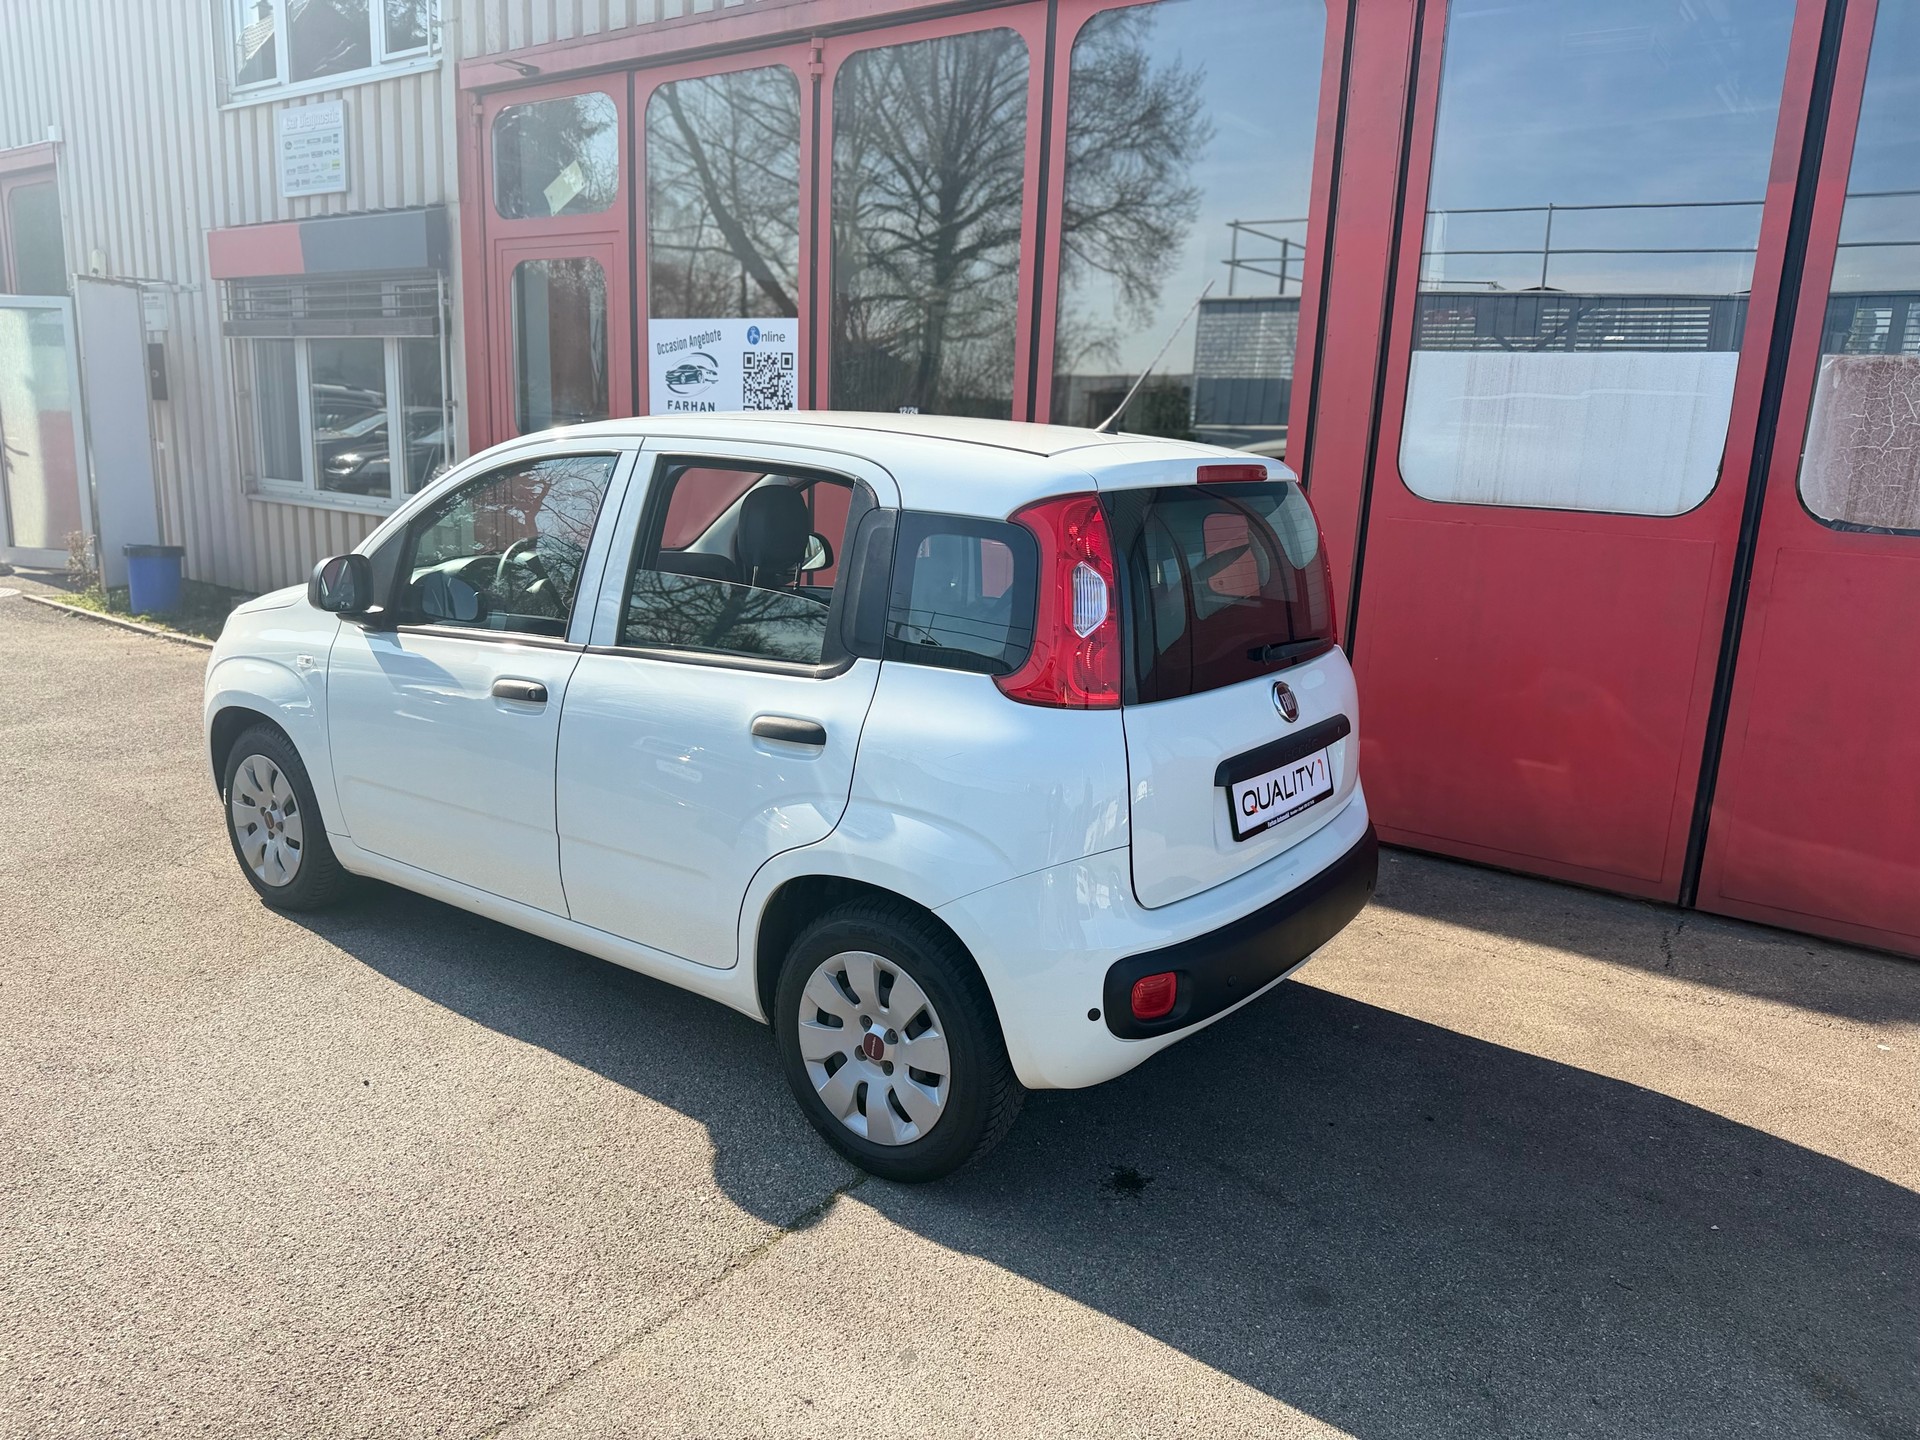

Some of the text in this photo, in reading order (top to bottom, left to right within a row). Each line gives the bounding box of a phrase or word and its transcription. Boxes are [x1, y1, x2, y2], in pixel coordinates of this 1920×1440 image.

[656, 329, 722, 355] Occasion Angebote
[667, 399, 715, 412] FARHAN
[1279, 692, 1296, 711] FIAT
